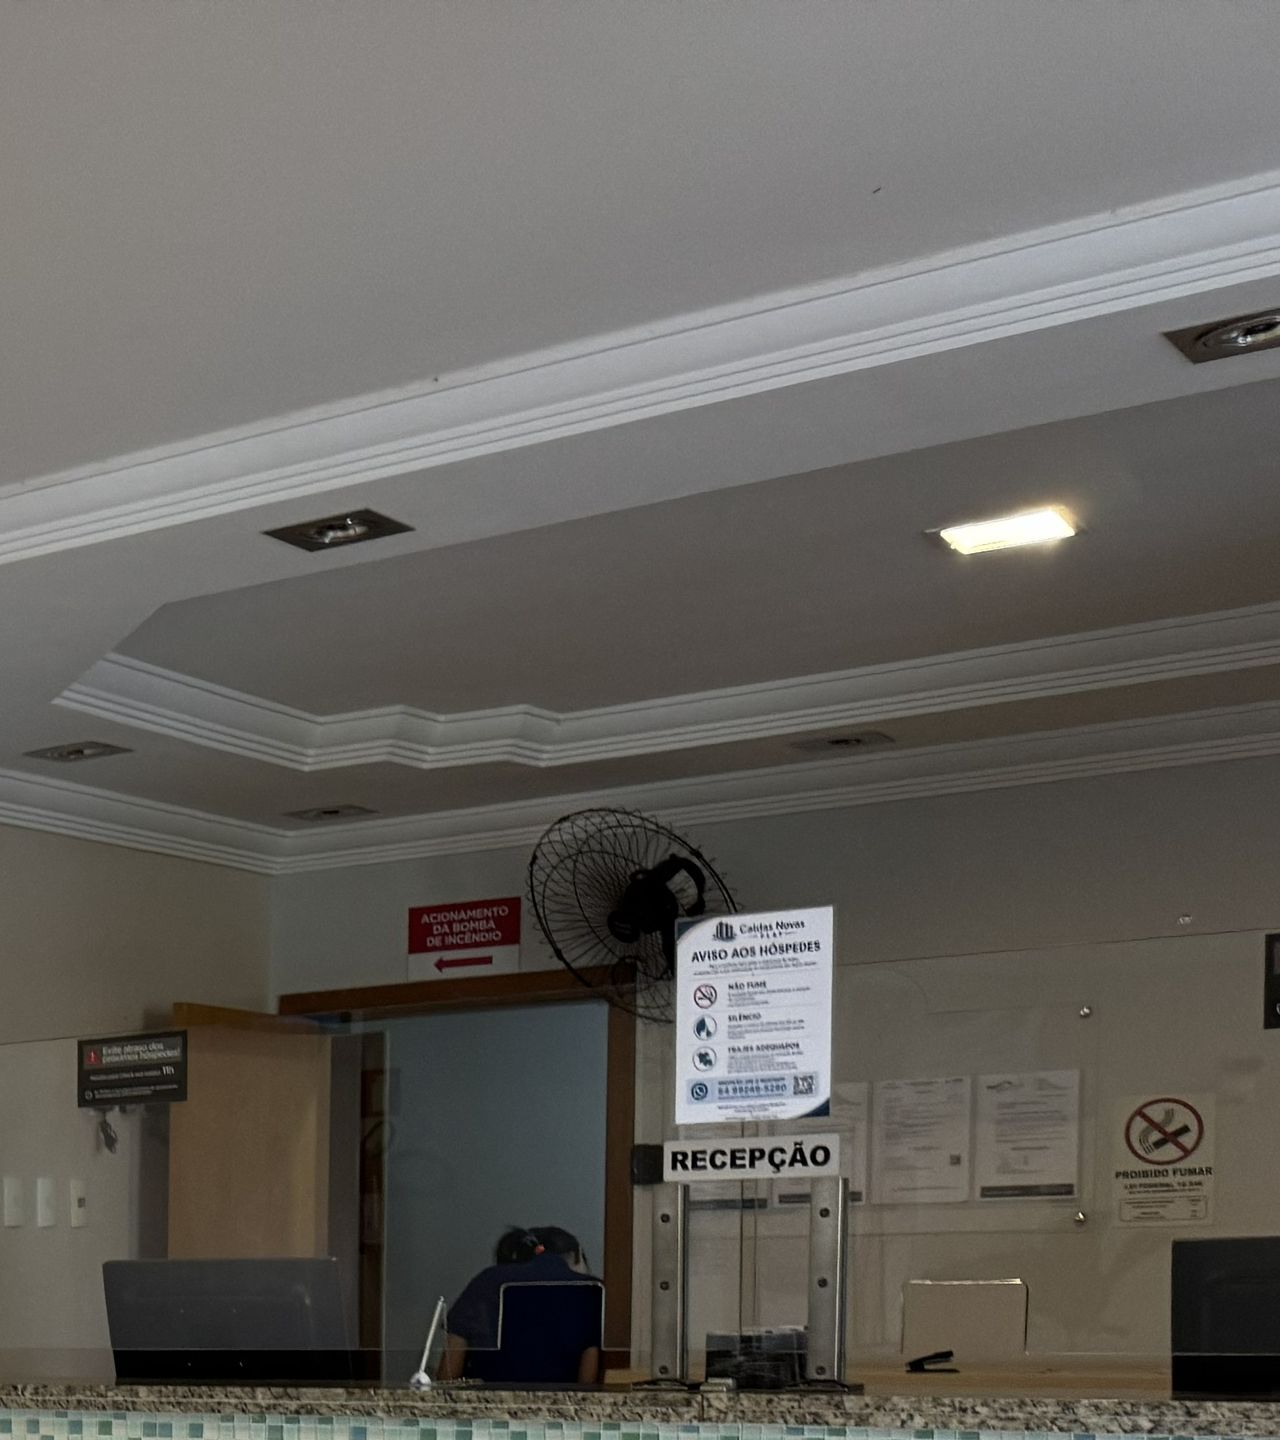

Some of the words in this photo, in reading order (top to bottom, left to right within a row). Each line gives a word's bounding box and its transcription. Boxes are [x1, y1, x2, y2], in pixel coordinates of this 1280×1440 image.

[421, 905, 509, 925] ACIONAMENTO
[432, 923, 450, 935] DA
[452, 919, 496, 932] BOMBA
[427, 936, 442, 947] DE
[444, 930, 502, 945] INCÊNDIO
[691, 948, 728, 963] AVISO
[731, 945, 756, 959] AOS
[760, 939, 821, 957] HÓSPEDES
[671, 1140, 831, 1174] RECEPÇÃO
[1115, 1168, 1169, 1180] PROIBIDO
[1172, 1166, 1213, 1177] FUMAR
